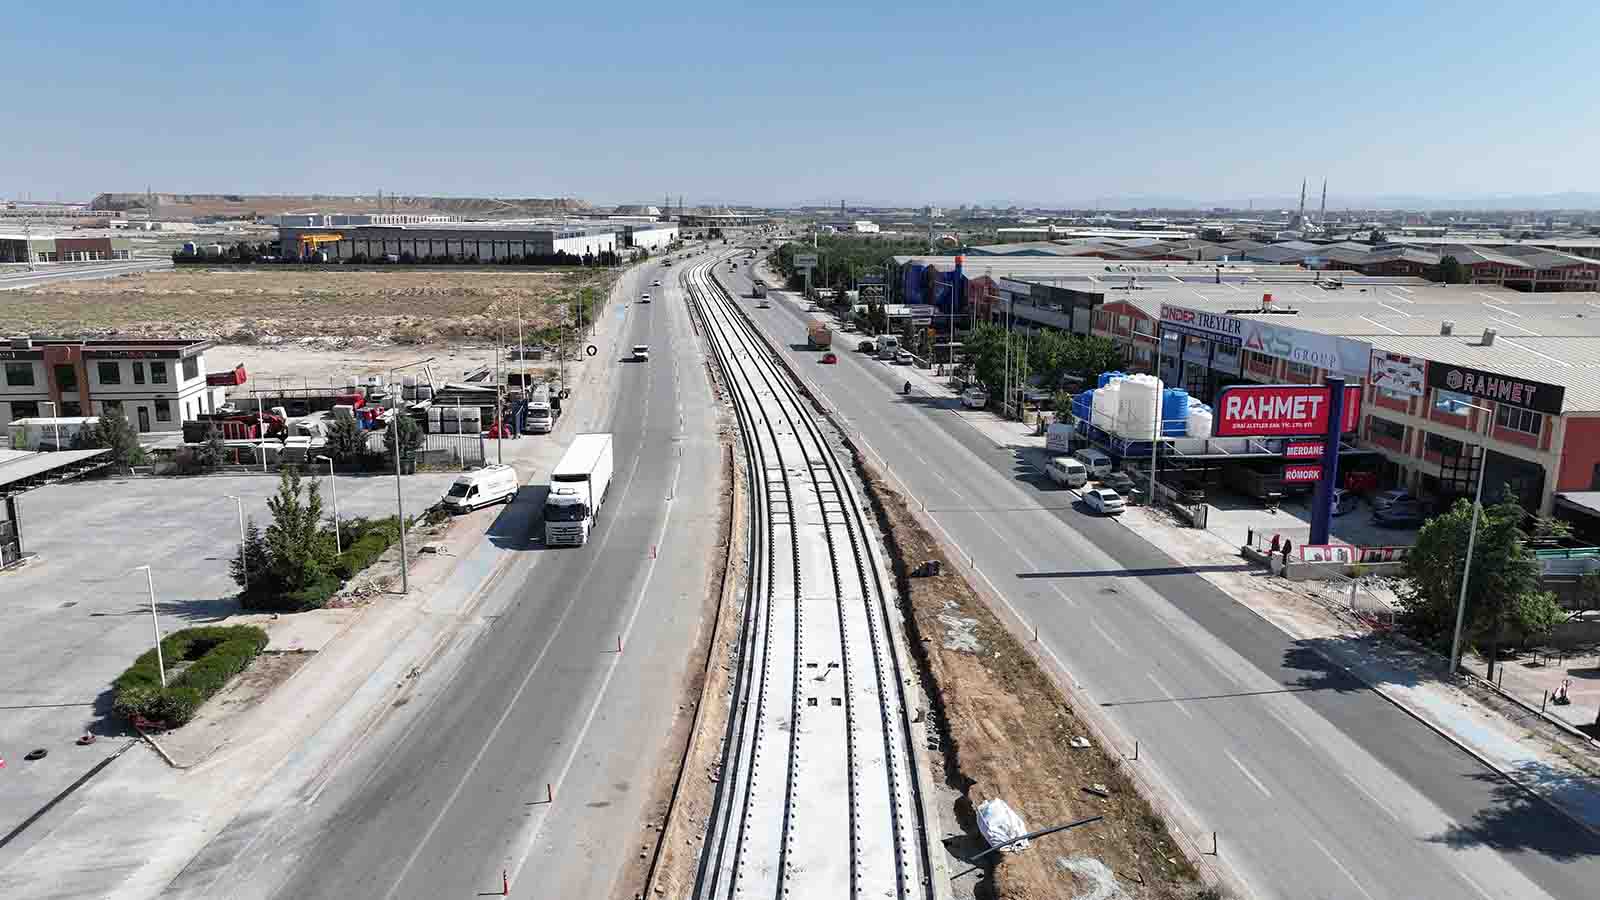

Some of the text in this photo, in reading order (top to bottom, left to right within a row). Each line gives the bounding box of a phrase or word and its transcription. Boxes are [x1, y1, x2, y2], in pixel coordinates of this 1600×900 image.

[1199, 312, 1241, 335] TREYLER
[1247, 326, 1292, 357] ARS
[1294, 349, 1336, 368] GROUP
[1463, 373, 1537, 403] RAHMET
[1225, 395, 1323, 420] RAHMET
[1287, 445, 1325, 456] MERDANE
[1286, 469, 1320, 480] RÖMORK
